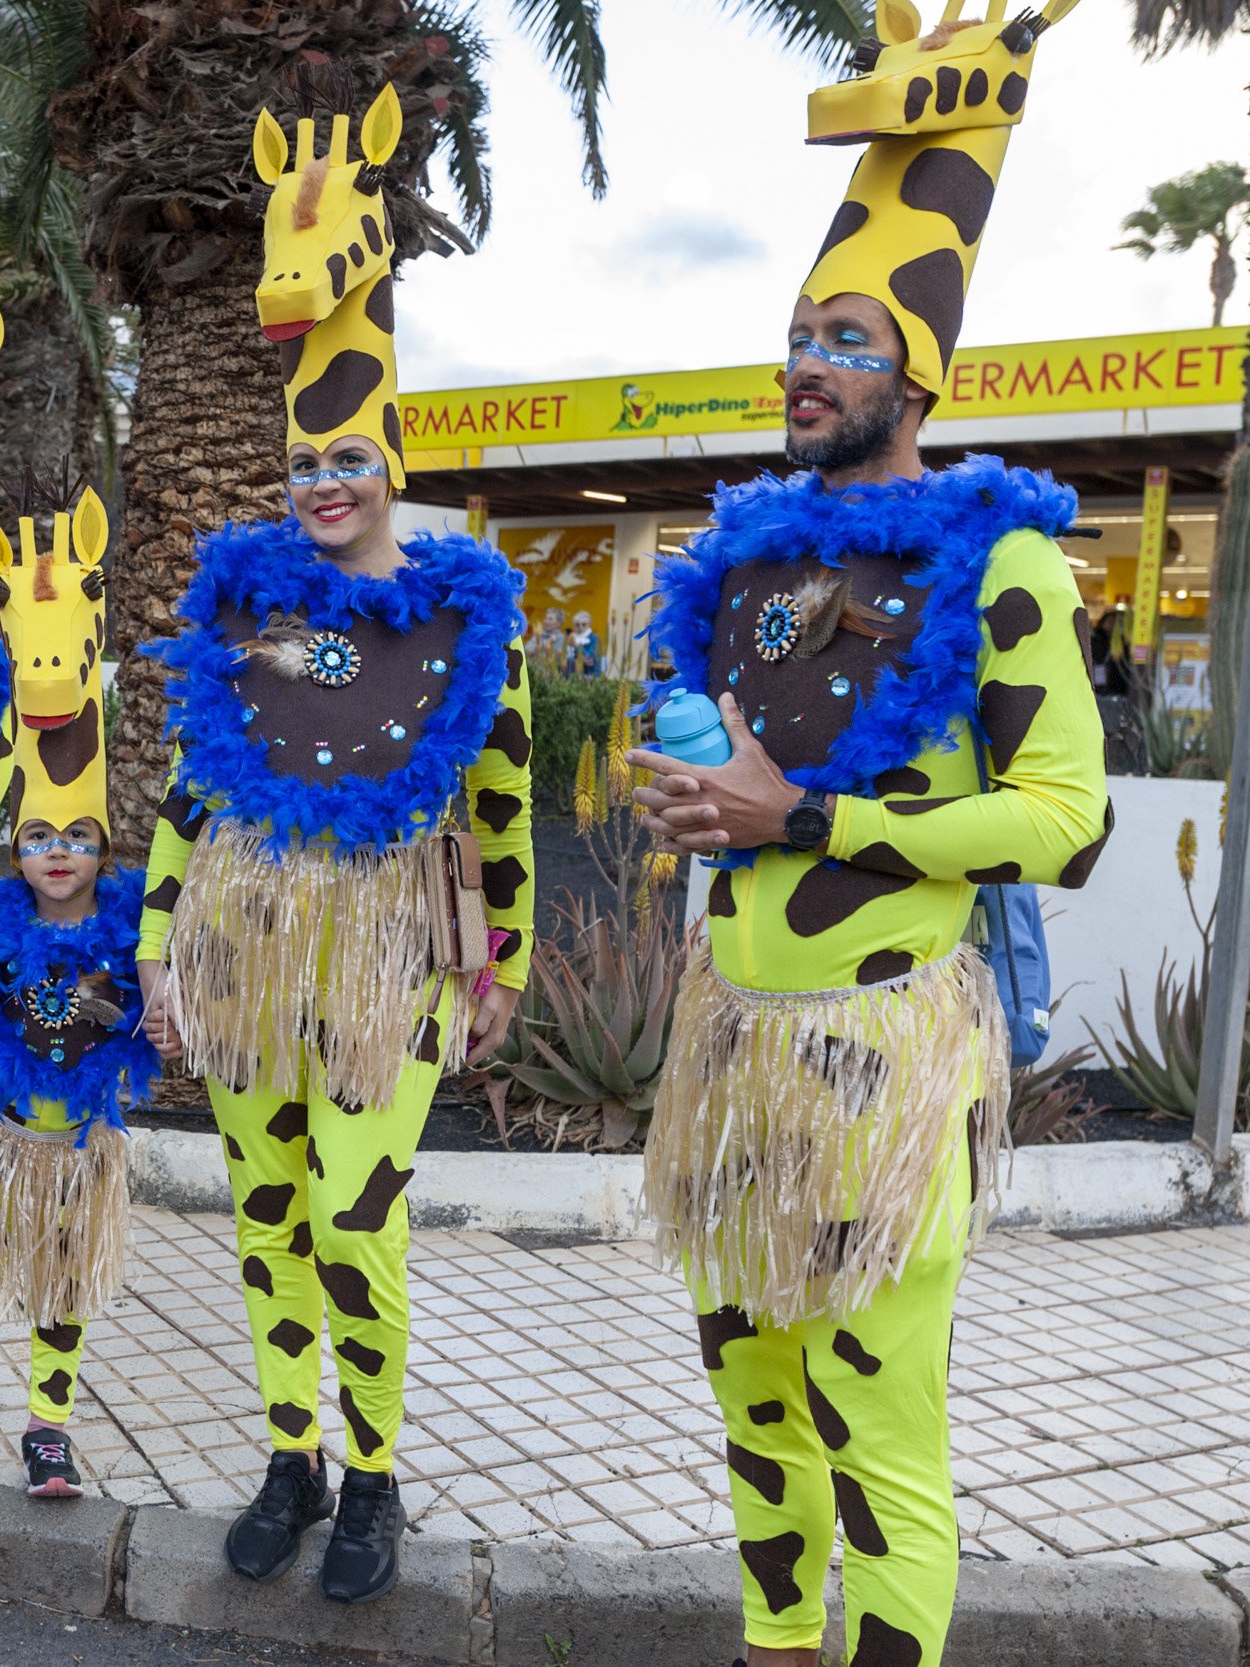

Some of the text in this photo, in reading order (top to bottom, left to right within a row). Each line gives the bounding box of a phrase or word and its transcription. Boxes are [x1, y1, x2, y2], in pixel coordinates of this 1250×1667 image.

[951, 345, 1236, 402] ERMARKET
[398, 395, 568, 437] RMARKET
[655, 398, 750, 419] HiperDino
